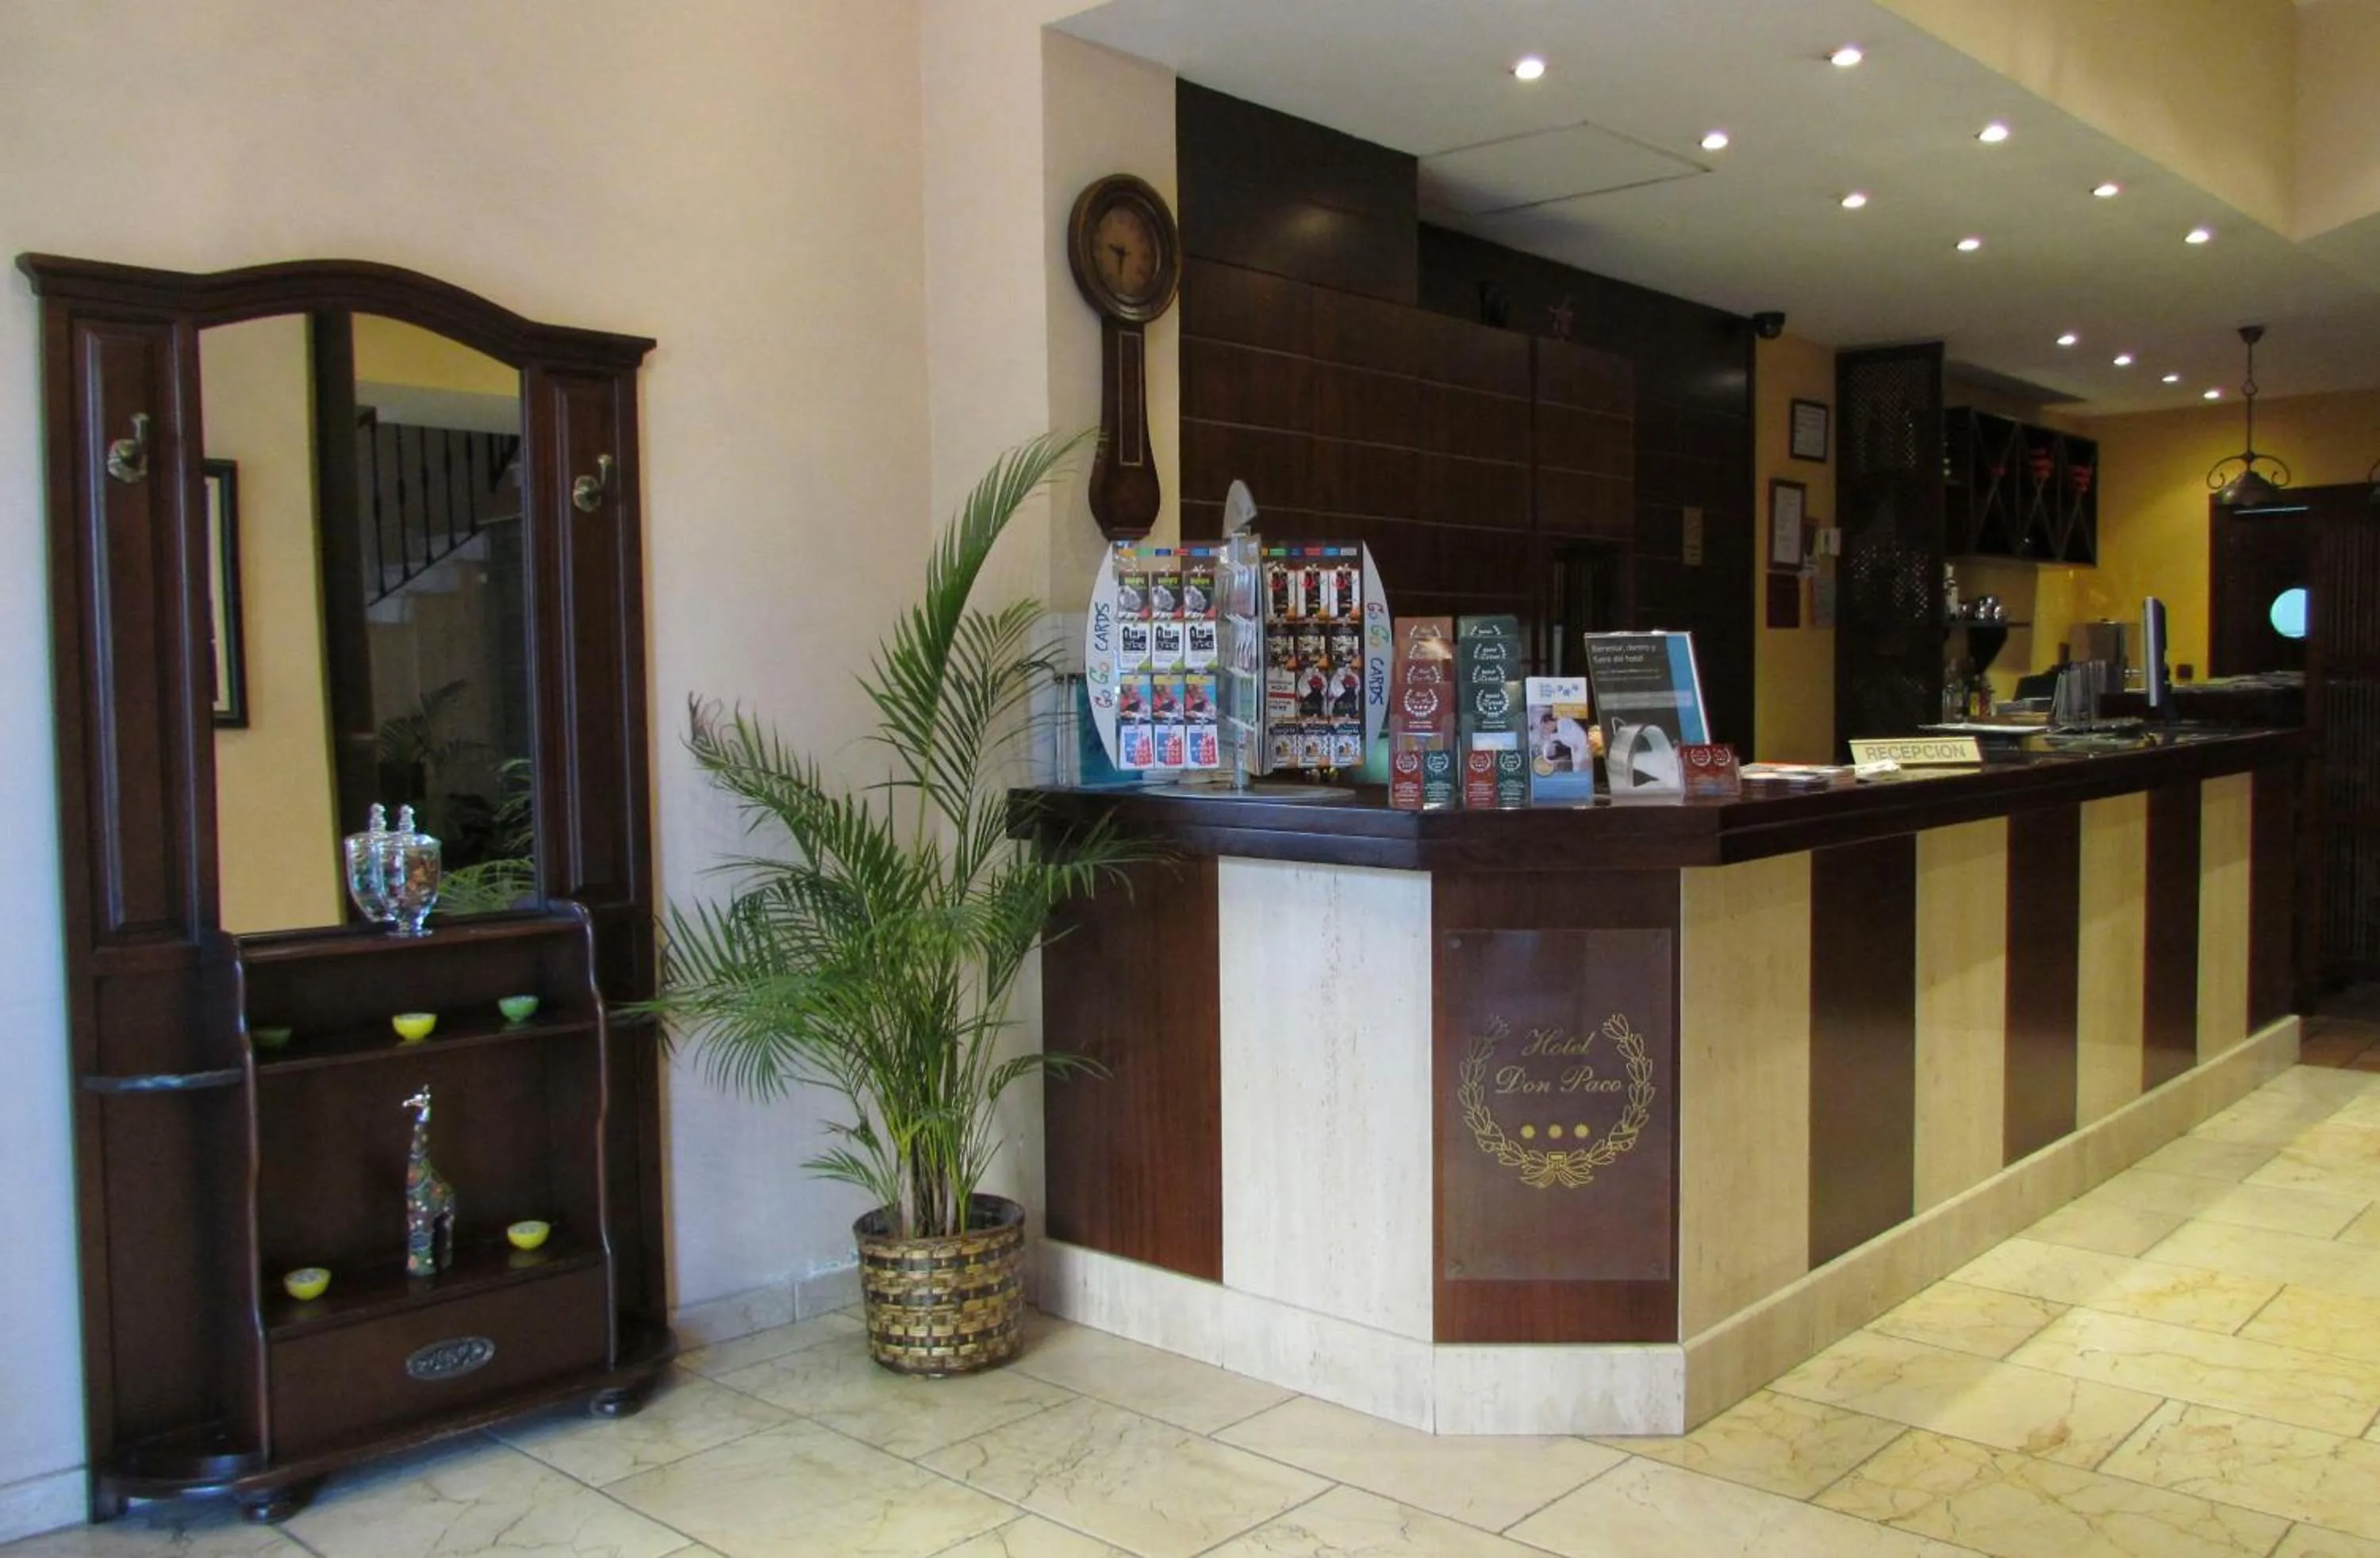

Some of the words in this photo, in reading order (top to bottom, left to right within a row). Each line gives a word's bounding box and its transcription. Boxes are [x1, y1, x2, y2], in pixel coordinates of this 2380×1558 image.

[1094, 601, 1110, 652] CARDS
[1368, 657, 1384, 706] CARDS
[1865, 744, 1967, 761] RECEPCION
[1522, 1028, 1596, 1057] Hotel
[1495, 1065, 1552, 1095] Don
[1559, 1065, 1622, 1093] Paco
